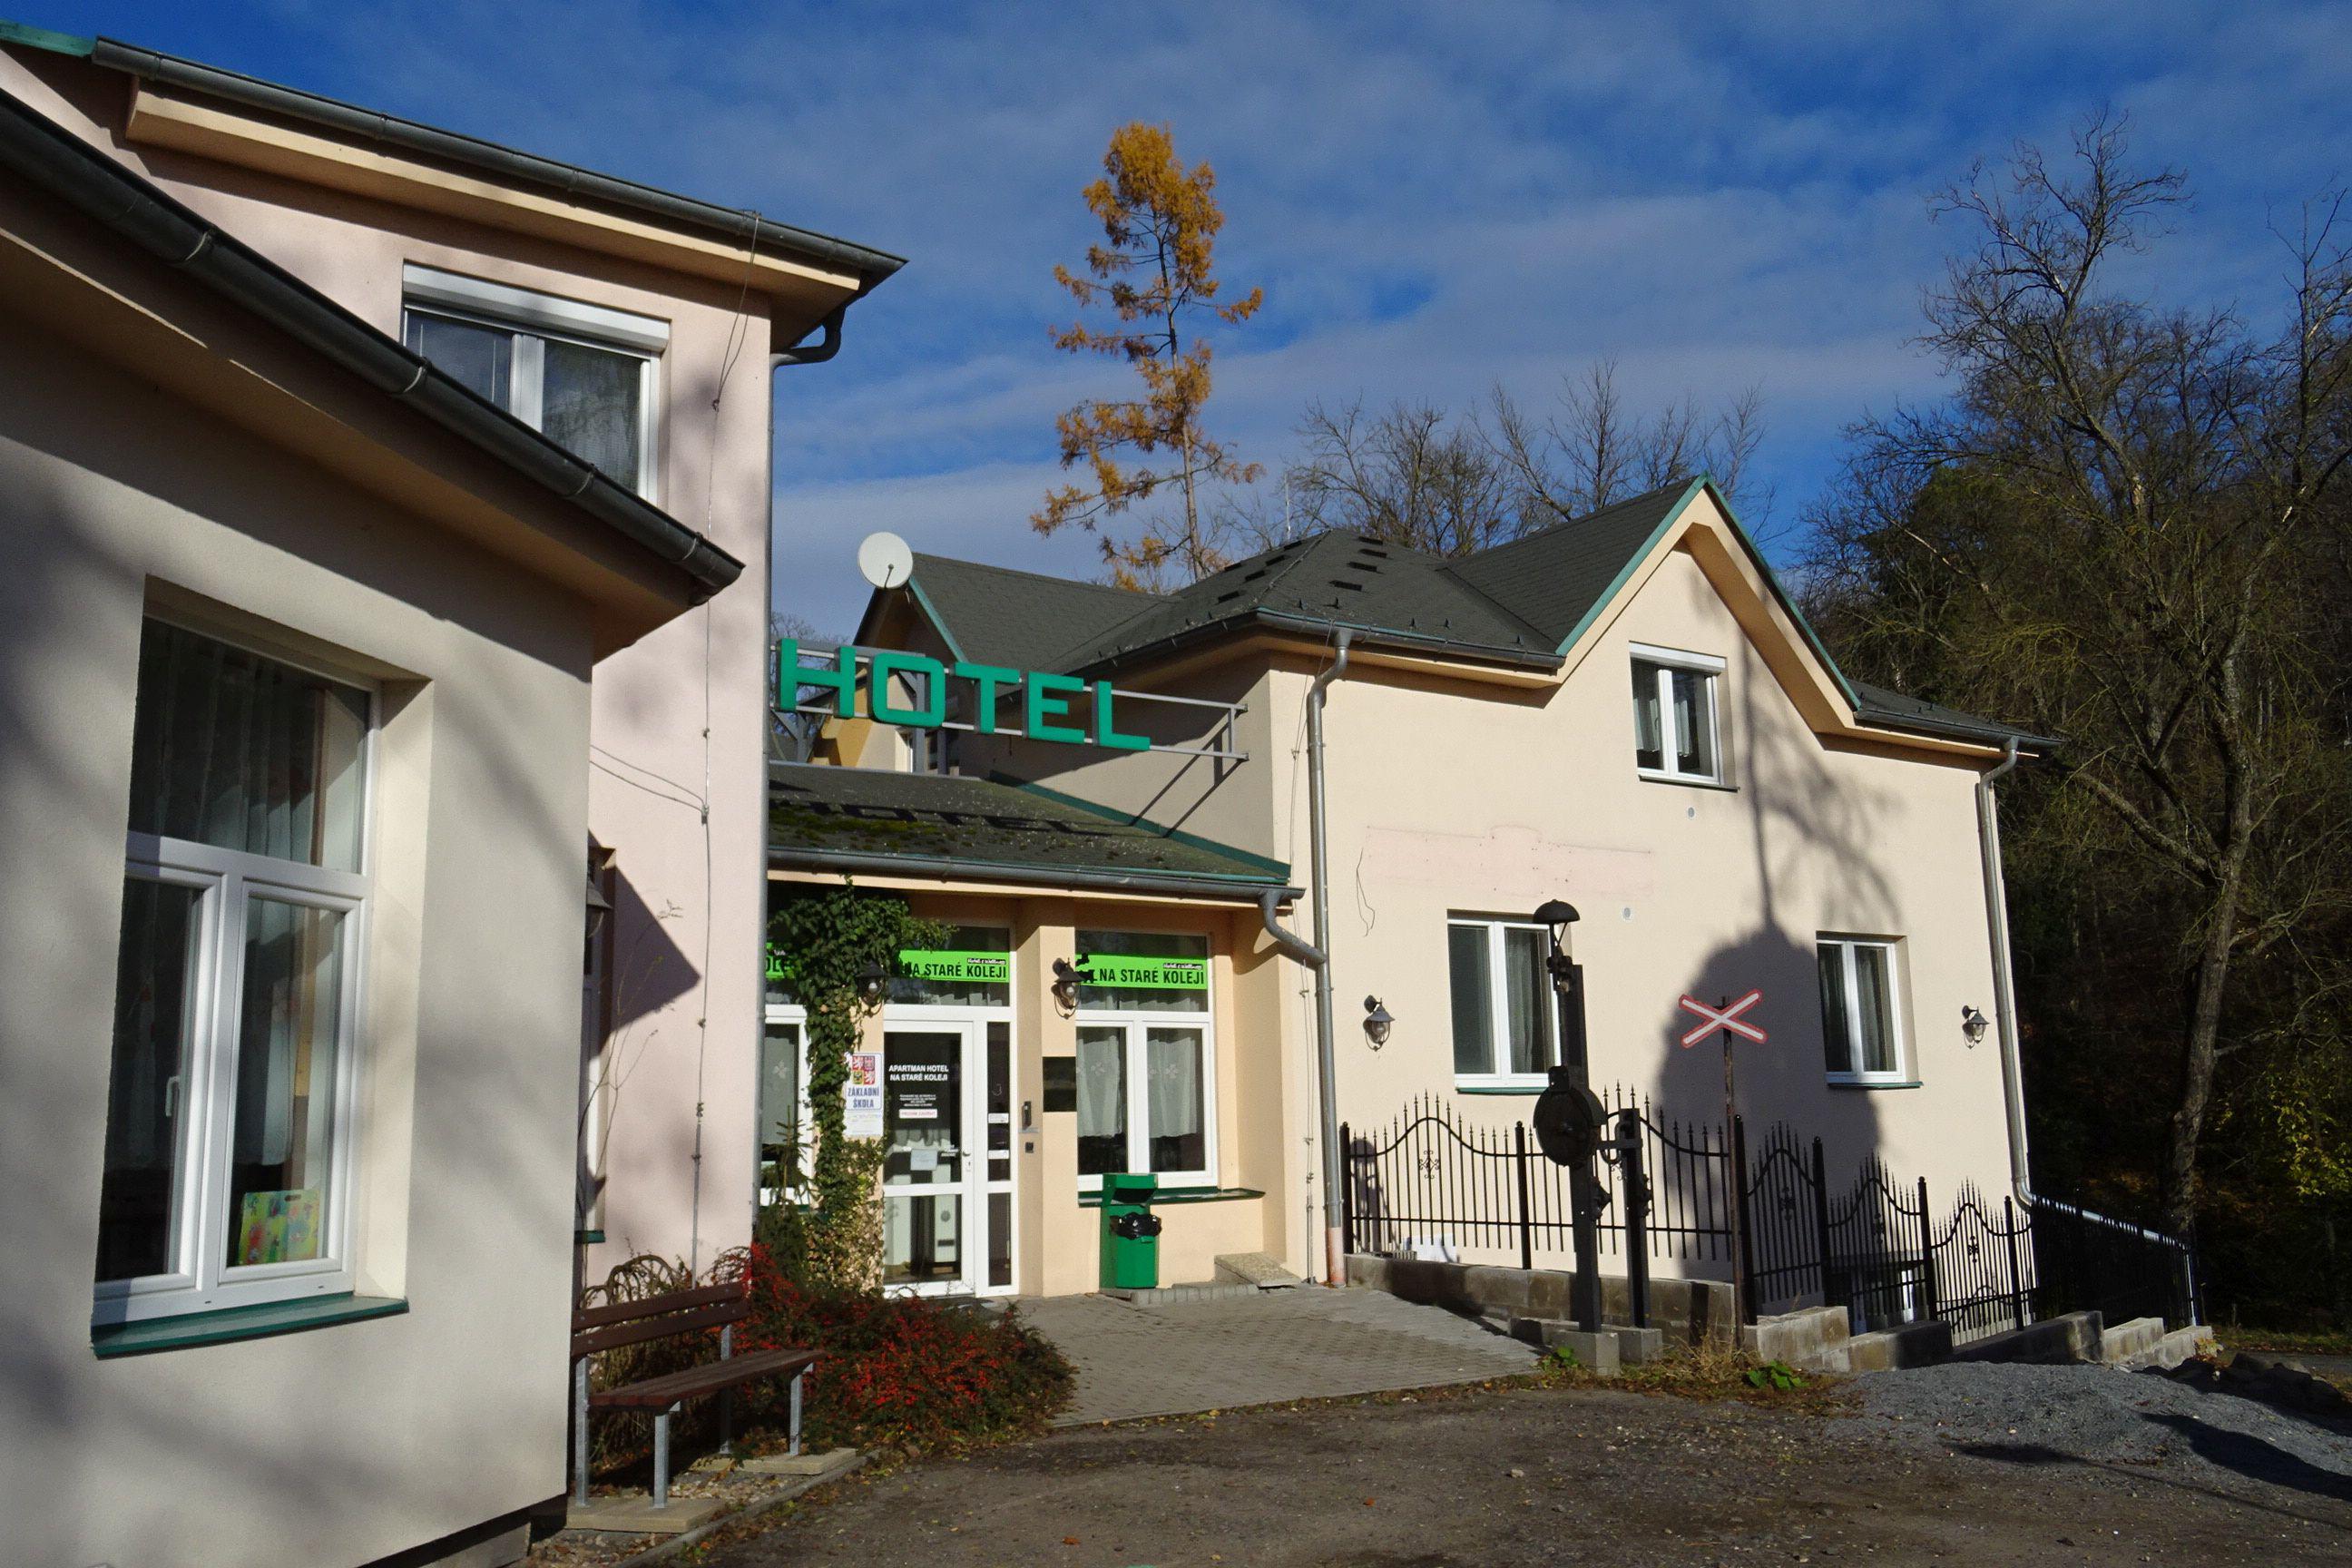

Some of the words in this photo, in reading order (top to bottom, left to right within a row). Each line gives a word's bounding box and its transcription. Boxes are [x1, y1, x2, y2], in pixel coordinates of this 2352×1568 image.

[777, 638, 1151, 750] HOTEL
[926, 962, 962, 976] STARÉ
[966, 965, 1006, 978] KOLEJI
[1099, 968, 1116, 982] NA
[1121, 967, 1159, 984] STARÉ
[1163, 970, 1204, 985] KOLEJI
[889, 1064, 926, 1073] APARTMAN
[926, 1064, 949, 1073] HOTEL
[890, 1073, 900, 1082] NA
[901, 1072, 923, 1082] STARÉ
[924, 1073, 948, 1082] KOLEJI
[848, 1086, 879, 1096] ZÁKLADNÍ
[853, 1098, 875, 1108] ŠKOLA
